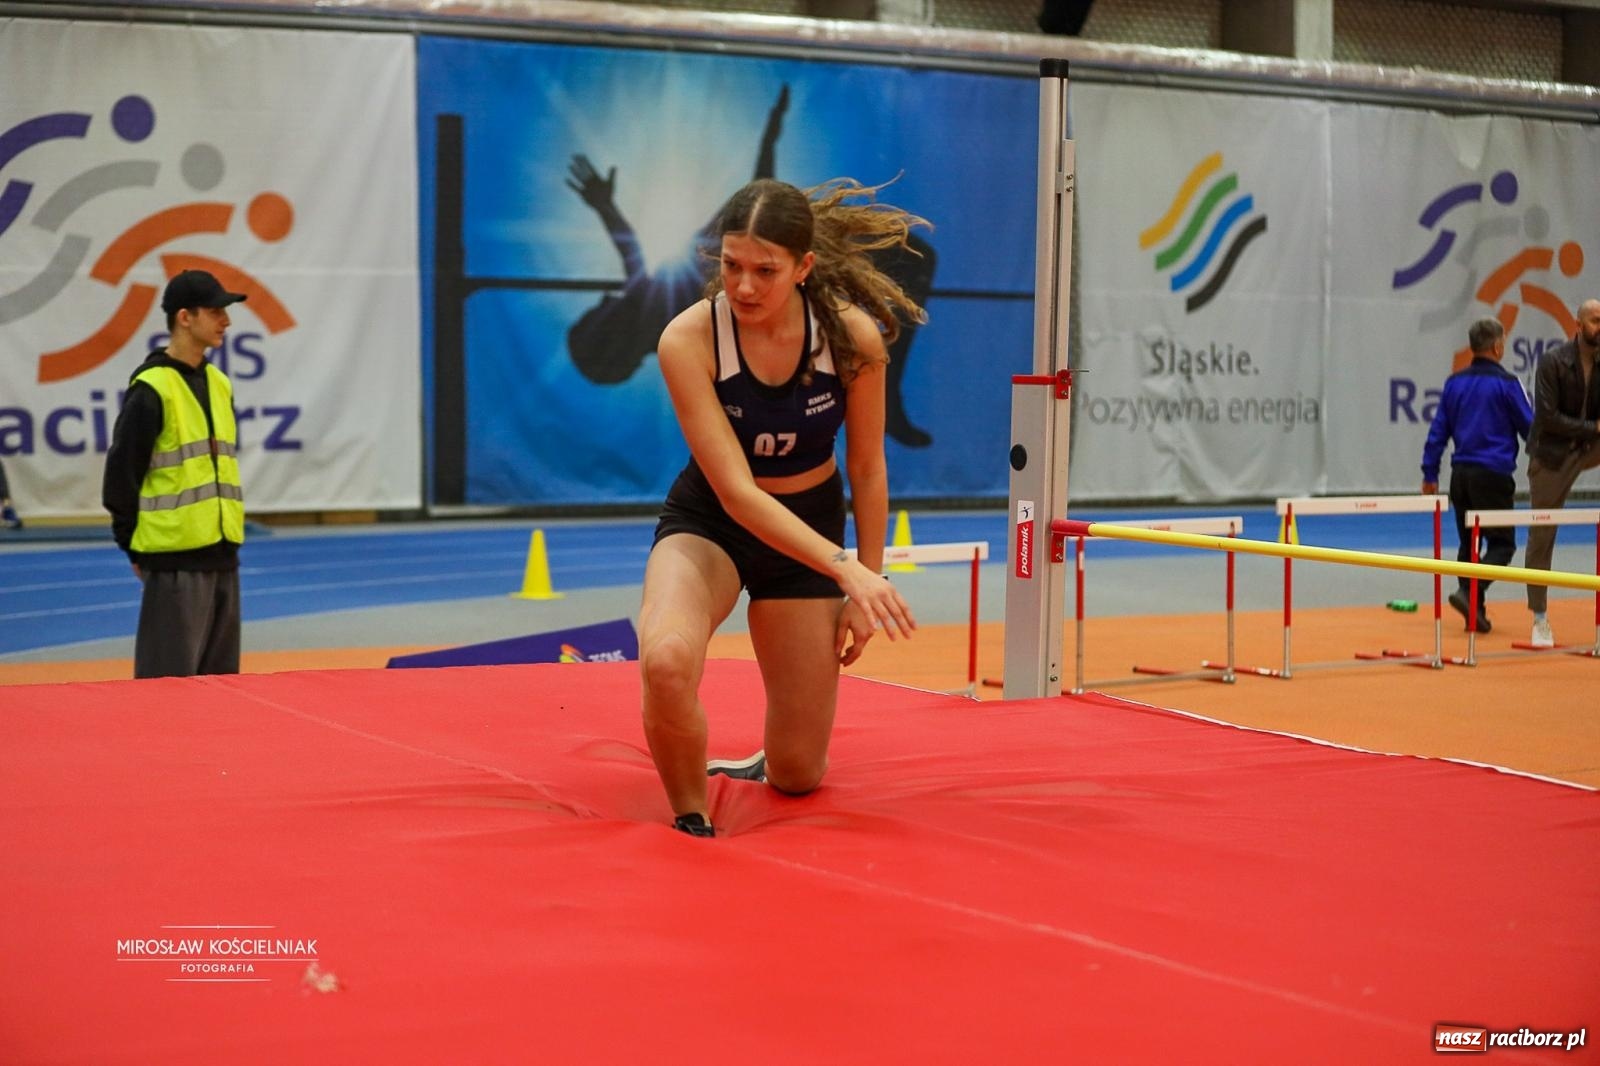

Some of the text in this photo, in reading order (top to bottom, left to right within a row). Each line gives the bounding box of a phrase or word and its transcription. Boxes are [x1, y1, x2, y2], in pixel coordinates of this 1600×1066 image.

[1150, 337, 1260, 383] Śląskie.
[1513, 336, 1564, 374] SM
[1228, 391, 1320, 433] energia
[1020, 526, 1030, 576] polanik
